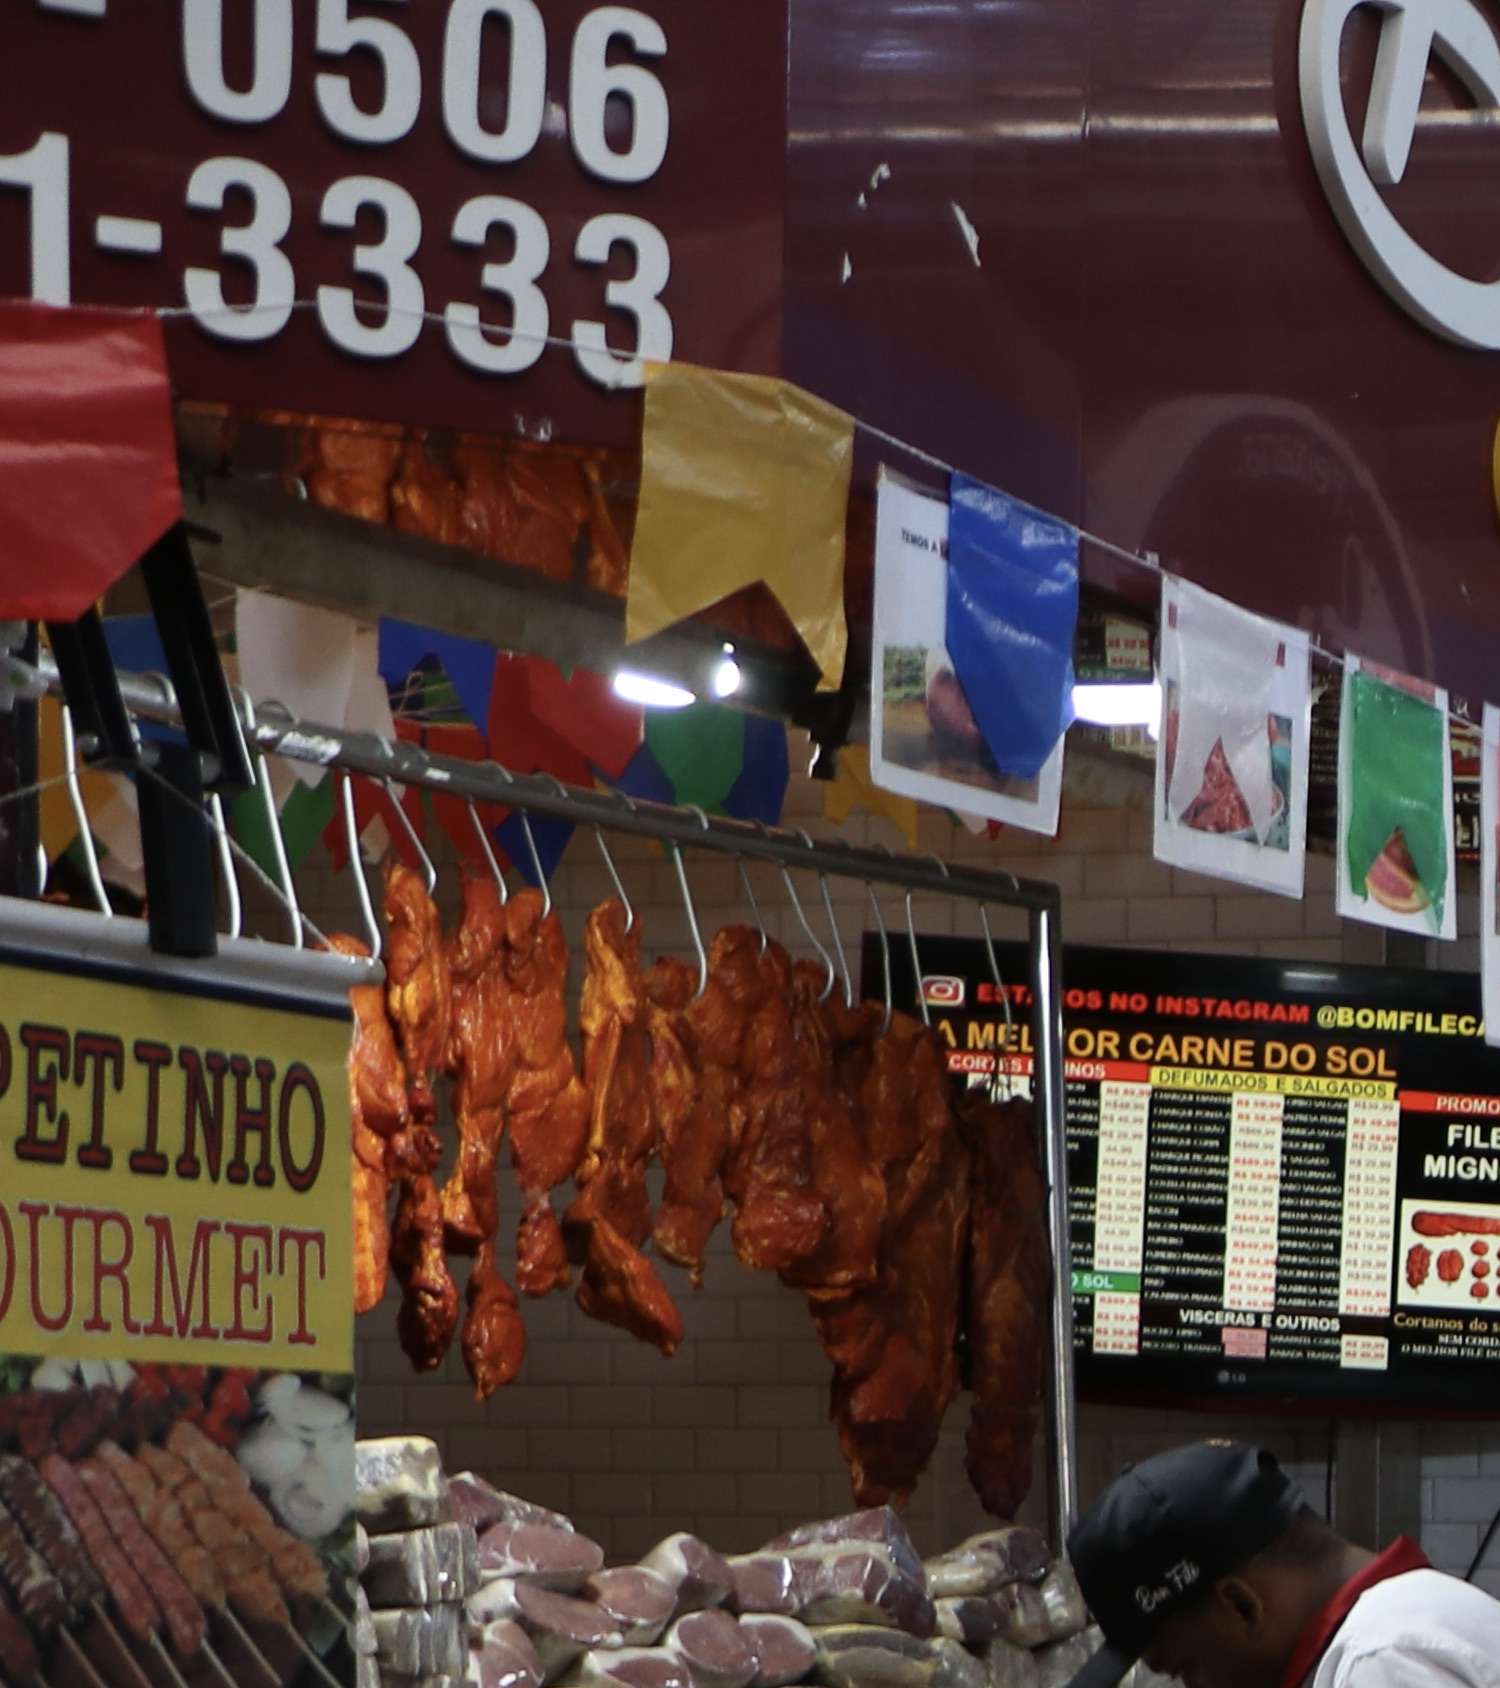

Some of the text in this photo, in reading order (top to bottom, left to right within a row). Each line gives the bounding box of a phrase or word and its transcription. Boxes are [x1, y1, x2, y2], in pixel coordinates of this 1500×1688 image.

[183, 0, 669, 185] 0506
[977, 983, 1101, 1010] ESTOS
[1109, 993, 1148, 1013] NO
[1156, 996, 1310, 1024] INSTAGRAM
[966, 1021, 1120, 1059] MELOR
[1129, 1031, 1253, 1068] CARNE
[1264, 1037, 1317, 1073] DO
[1325, 1041, 1398, 1078] SOL
[1159, 1068, 1388, 1097] DEFUMADOS E SALGADOS
[1179, 1308, 1341, 1332] VISCERAS E OUTROS
[1393, 1312, 1464, 1331] Cortamos
[1469, 1316, 1488, 1332] do
